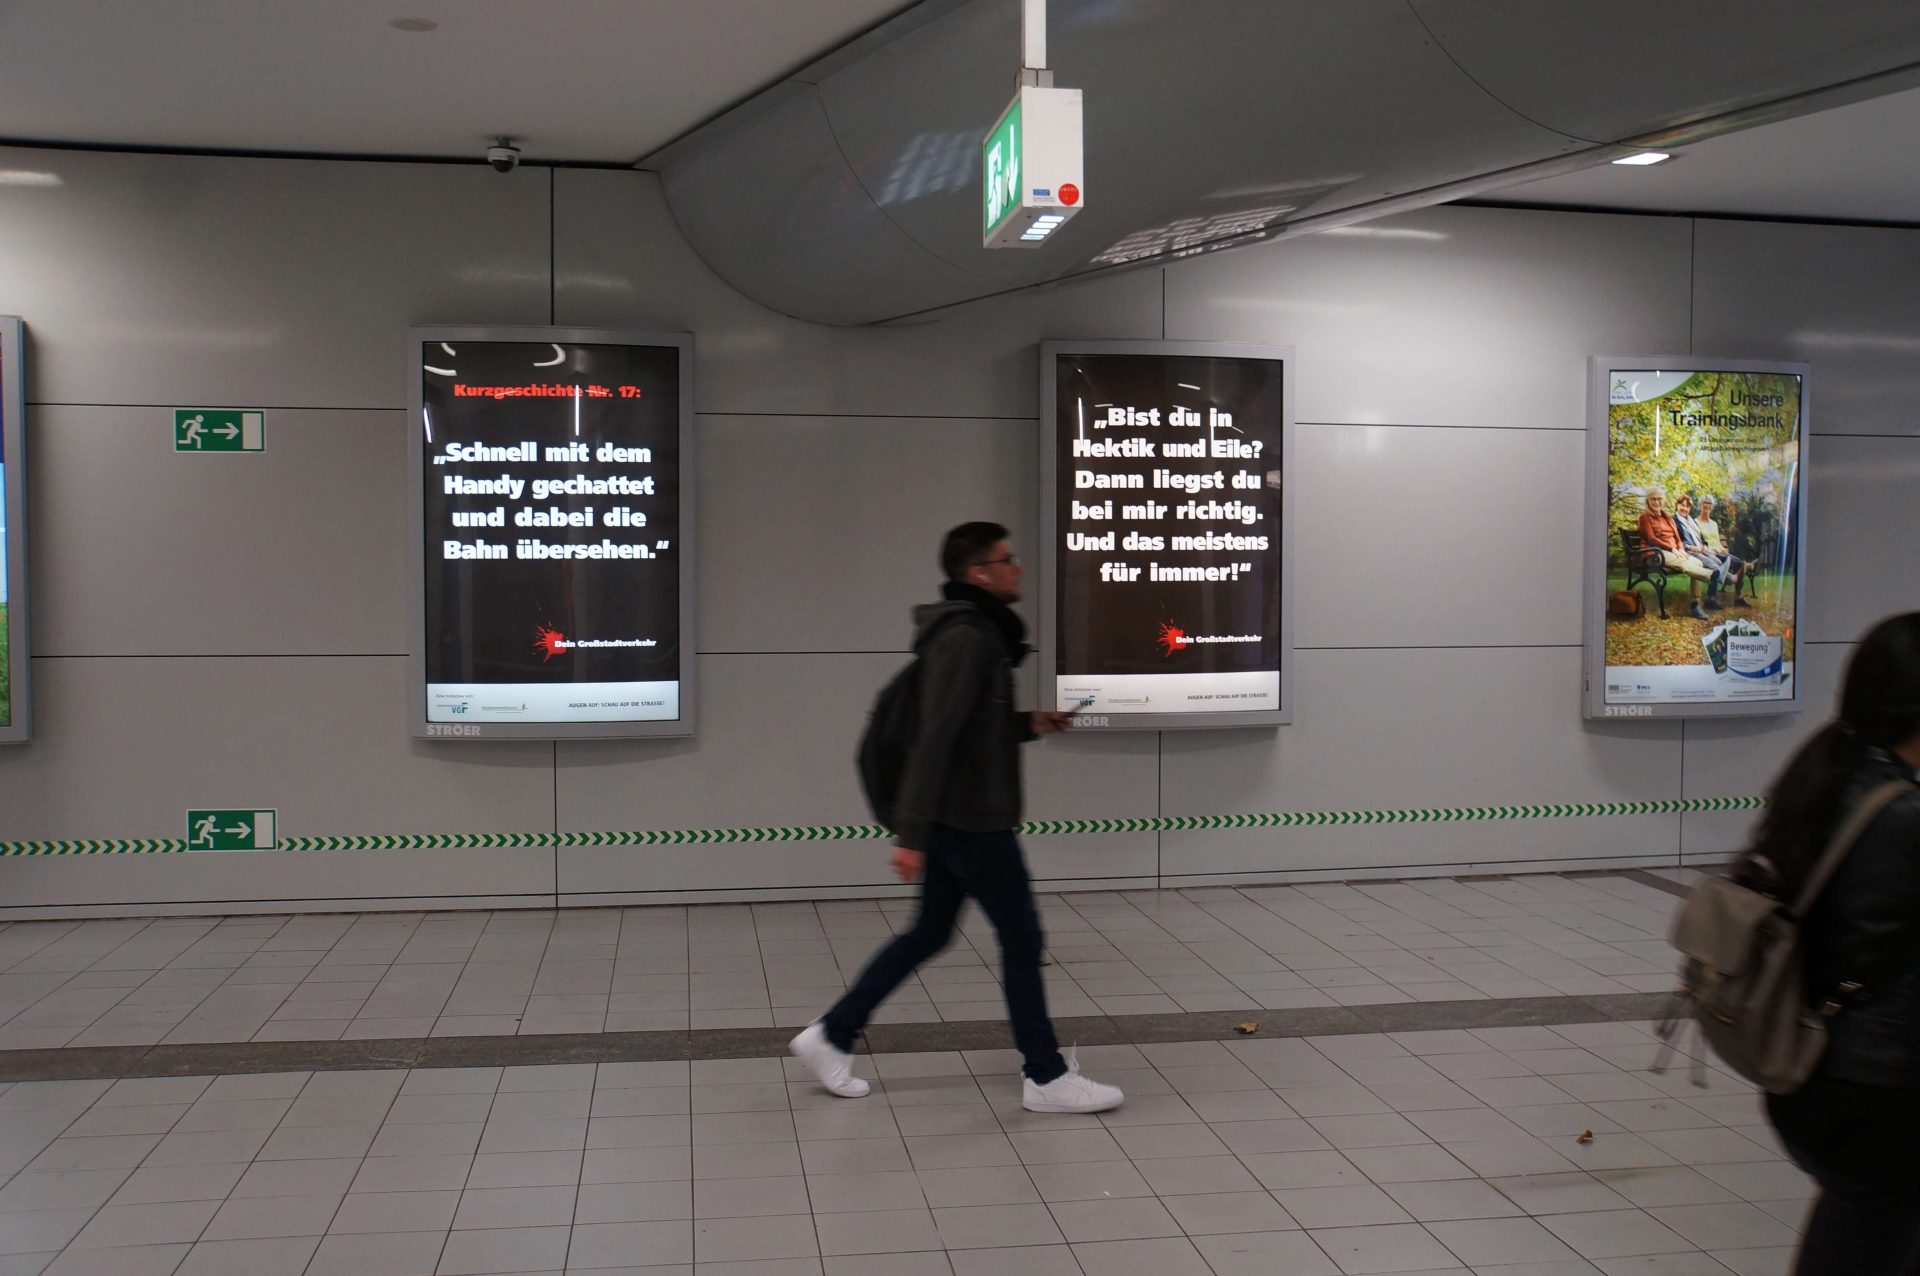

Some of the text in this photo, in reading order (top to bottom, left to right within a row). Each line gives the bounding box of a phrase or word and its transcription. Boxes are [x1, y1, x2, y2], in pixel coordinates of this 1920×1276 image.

[454, 384, 641, 399] Kurzgeschichte Nr. 17:
[1730, 390, 1784, 407] Unsere
[1094, 407, 1232, 429] „Bist du in
[1669, 410, 1784, 430] Trainingsbank
[433, 441, 652, 465] „Schnell mit dem
[1073, 438, 1264, 458] Hektik und Eile?
[444, 474, 655, 500] Handy gechattet
[1075, 469, 1262, 494] Dann liegst du
[452, 507, 647, 527] und dabei die
[1072, 501, 1264, 525] bei mir richtig.
[444, 539, 670, 560] Bahn übersehen.“
[1067, 532, 1269, 551] Und das meistens
[1100, 563, 1252, 582] für immer!“
[554, 640, 657, 648] Dein Großstadtverkehr
[1175, 635, 1262, 644] Dein Großstadtverkehr
[1730, 642, 1769, 654] Bewegung
[1604, 706, 1653, 717] STRÖER
[426, 724, 481, 736] STRÖER
